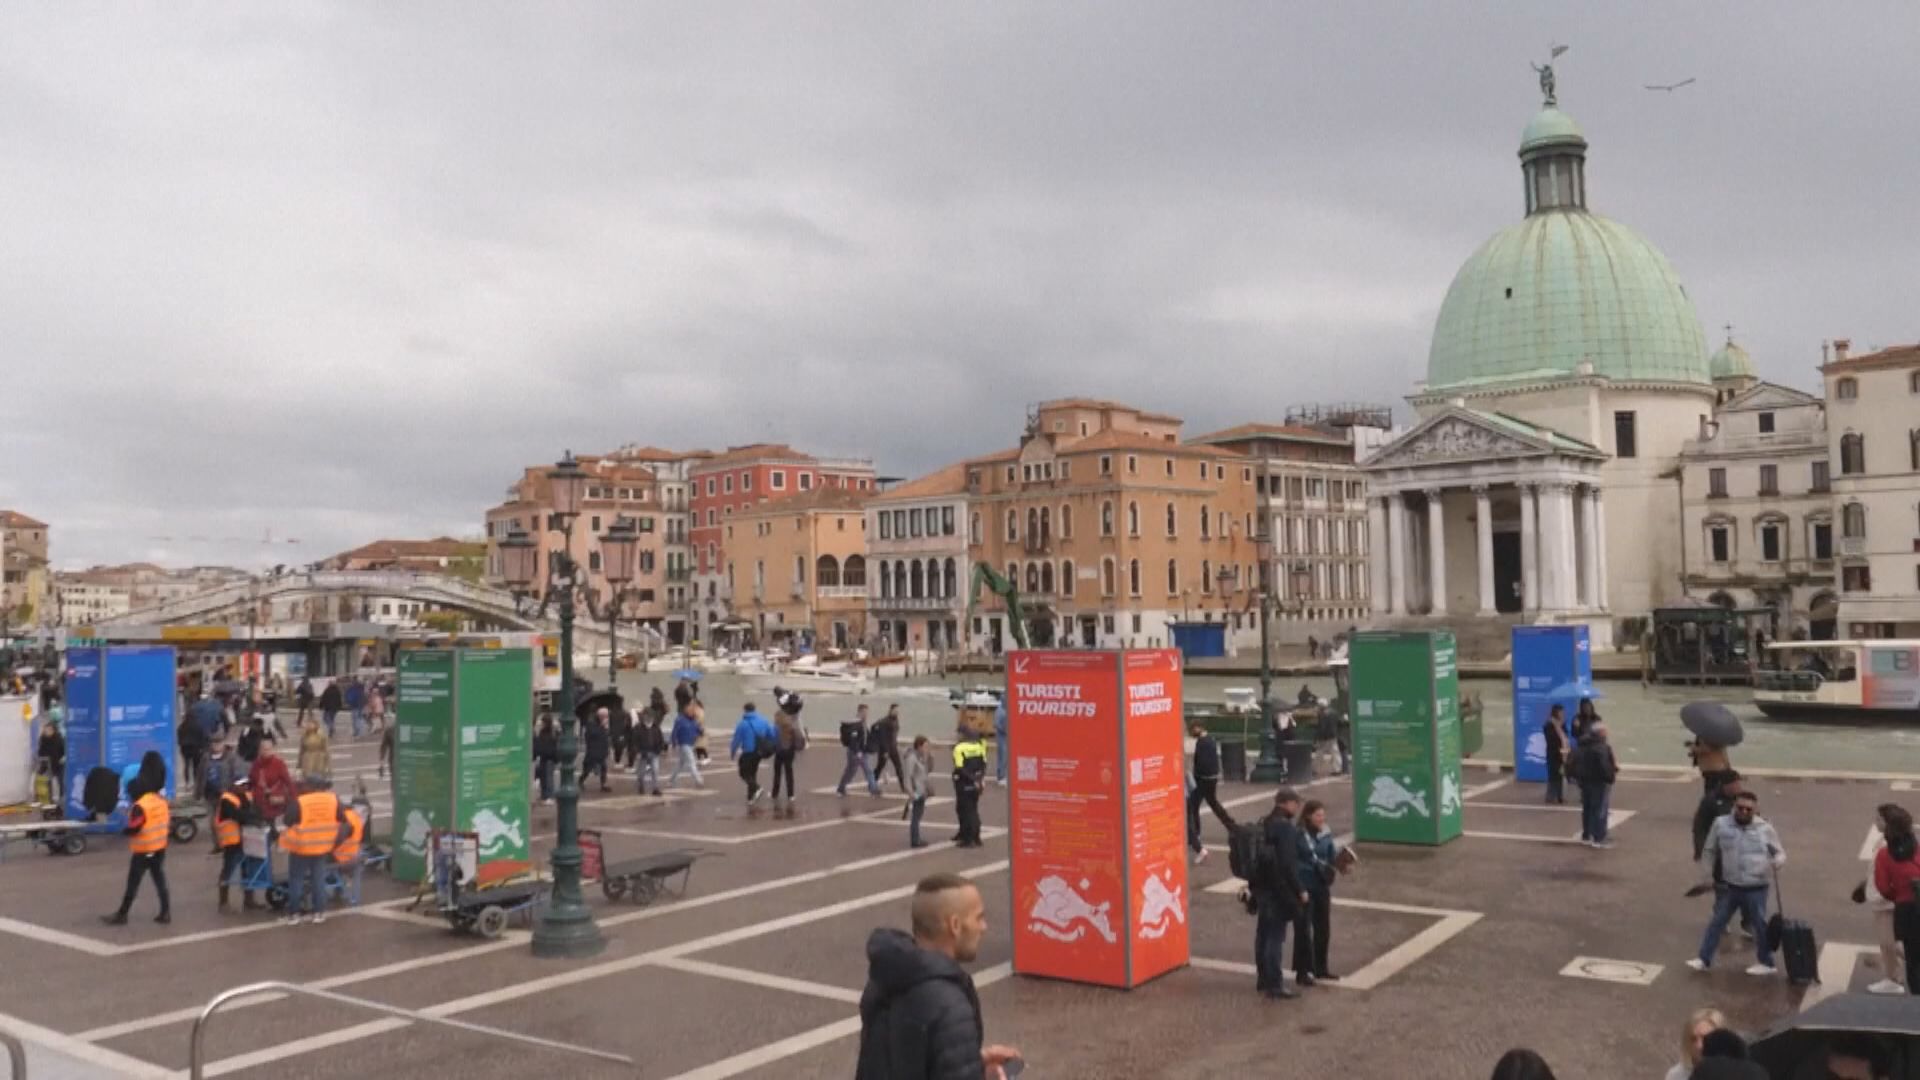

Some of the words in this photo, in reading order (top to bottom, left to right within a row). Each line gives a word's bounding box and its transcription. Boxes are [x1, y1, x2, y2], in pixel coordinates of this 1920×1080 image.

[1016, 684, 1081, 699] TURISTI
[1128, 682, 1164, 699] TURISTI
[1018, 700, 1096, 717] TOURISTS
[1130, 698, 1172, 717] TOURISTS
